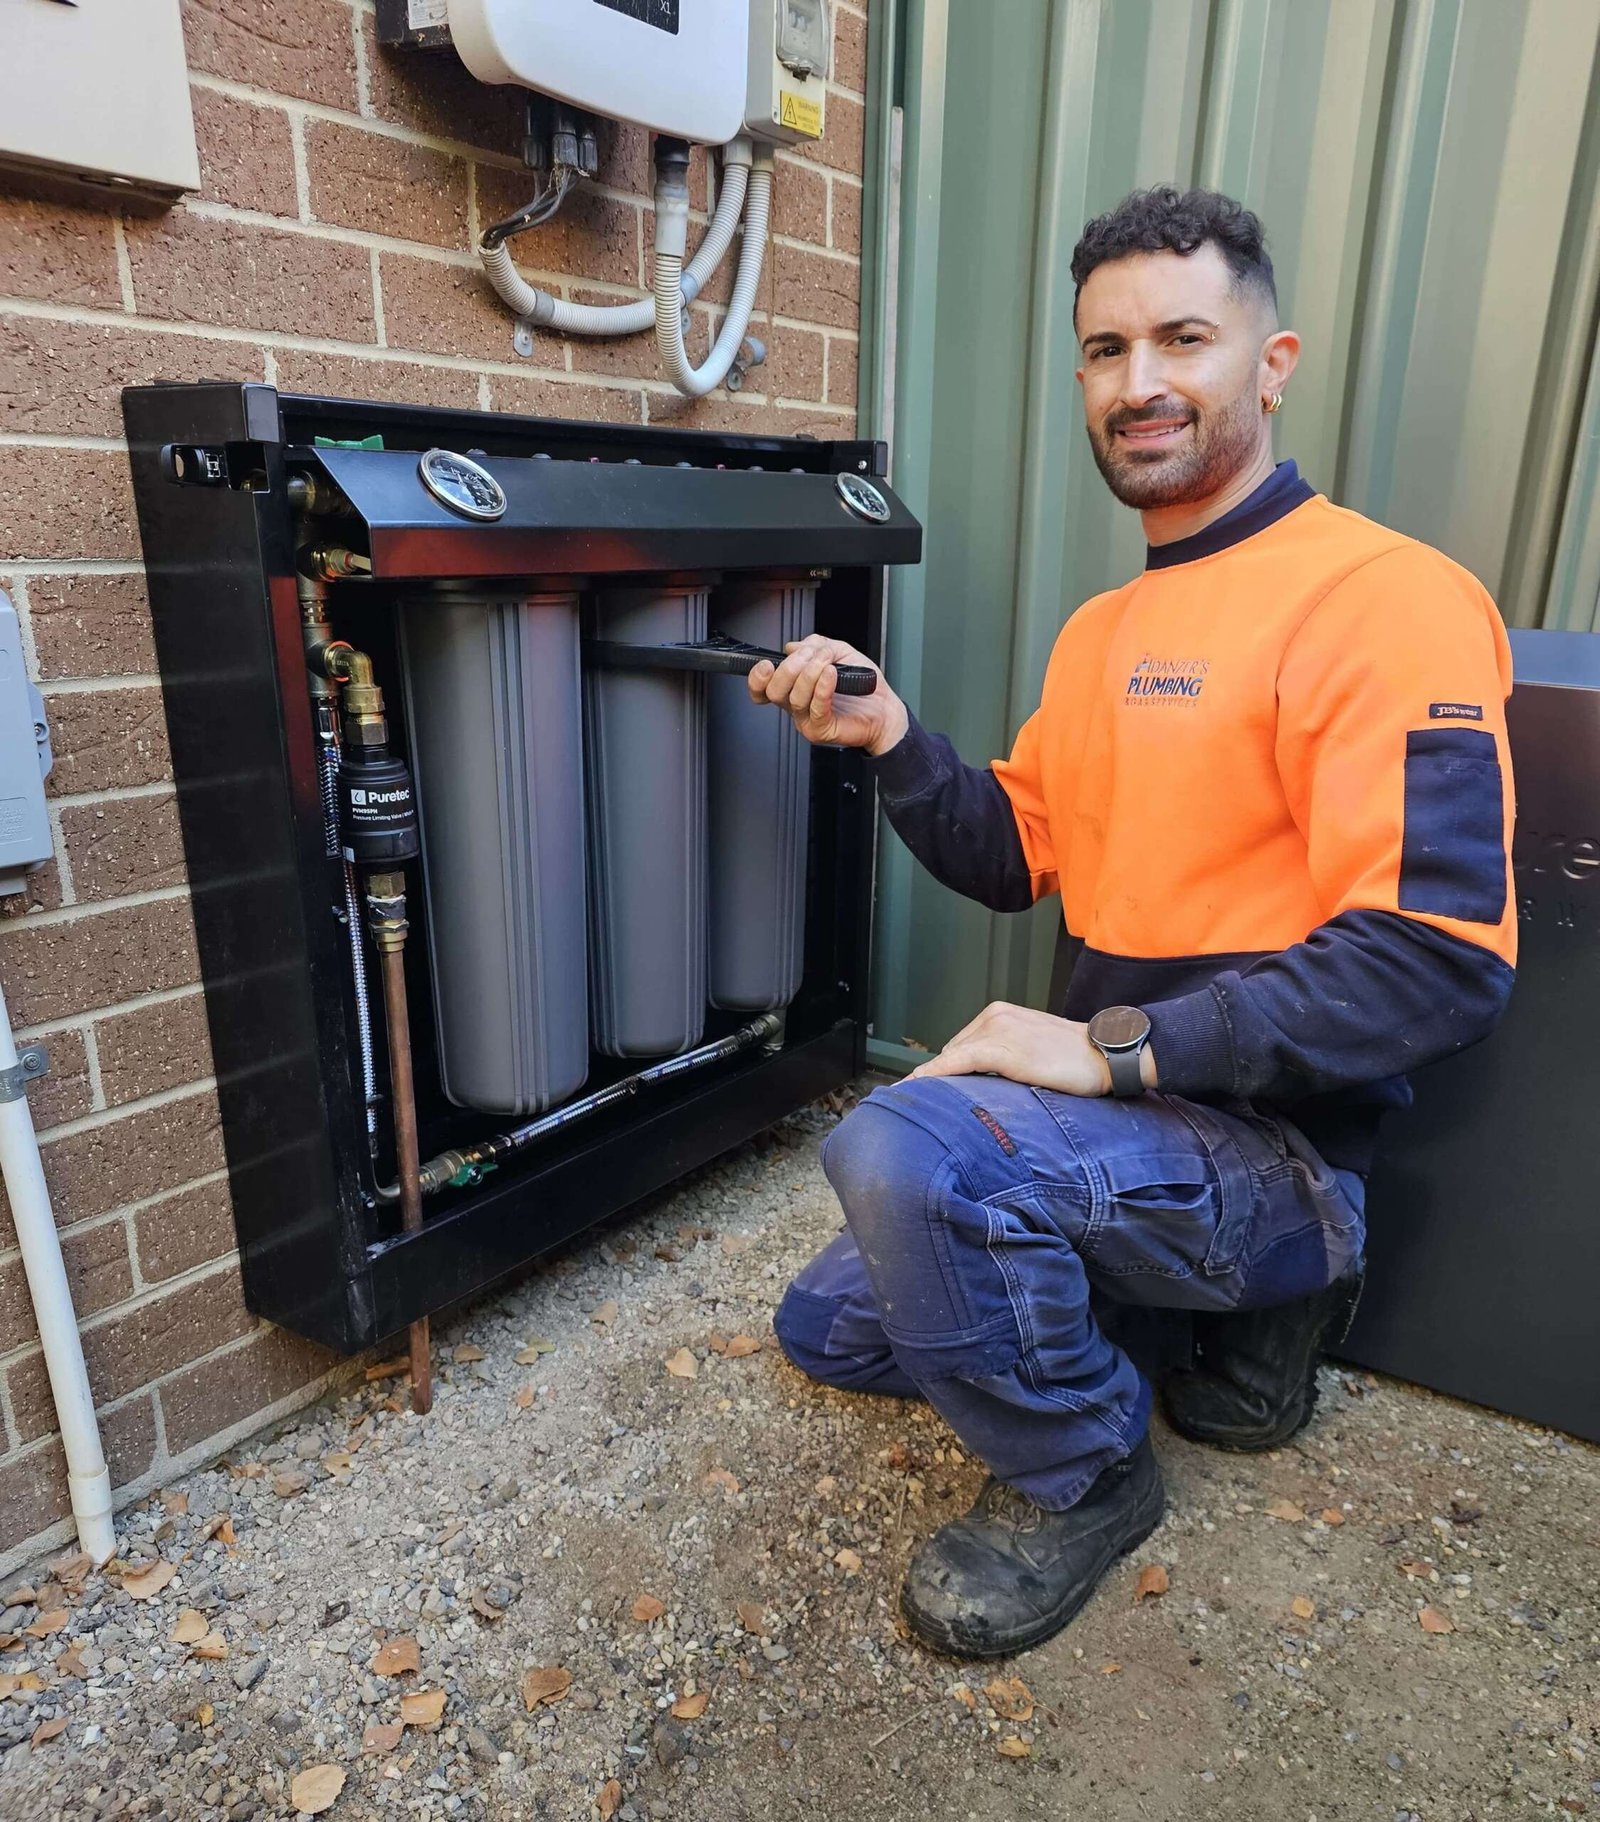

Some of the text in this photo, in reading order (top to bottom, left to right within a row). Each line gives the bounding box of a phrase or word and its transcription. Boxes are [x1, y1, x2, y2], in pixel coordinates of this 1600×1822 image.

[660, 0, 671, 15] X1
[1127, 676, 1203, 697] PLUMBING
[368, 789, 410, 804] Puretec
